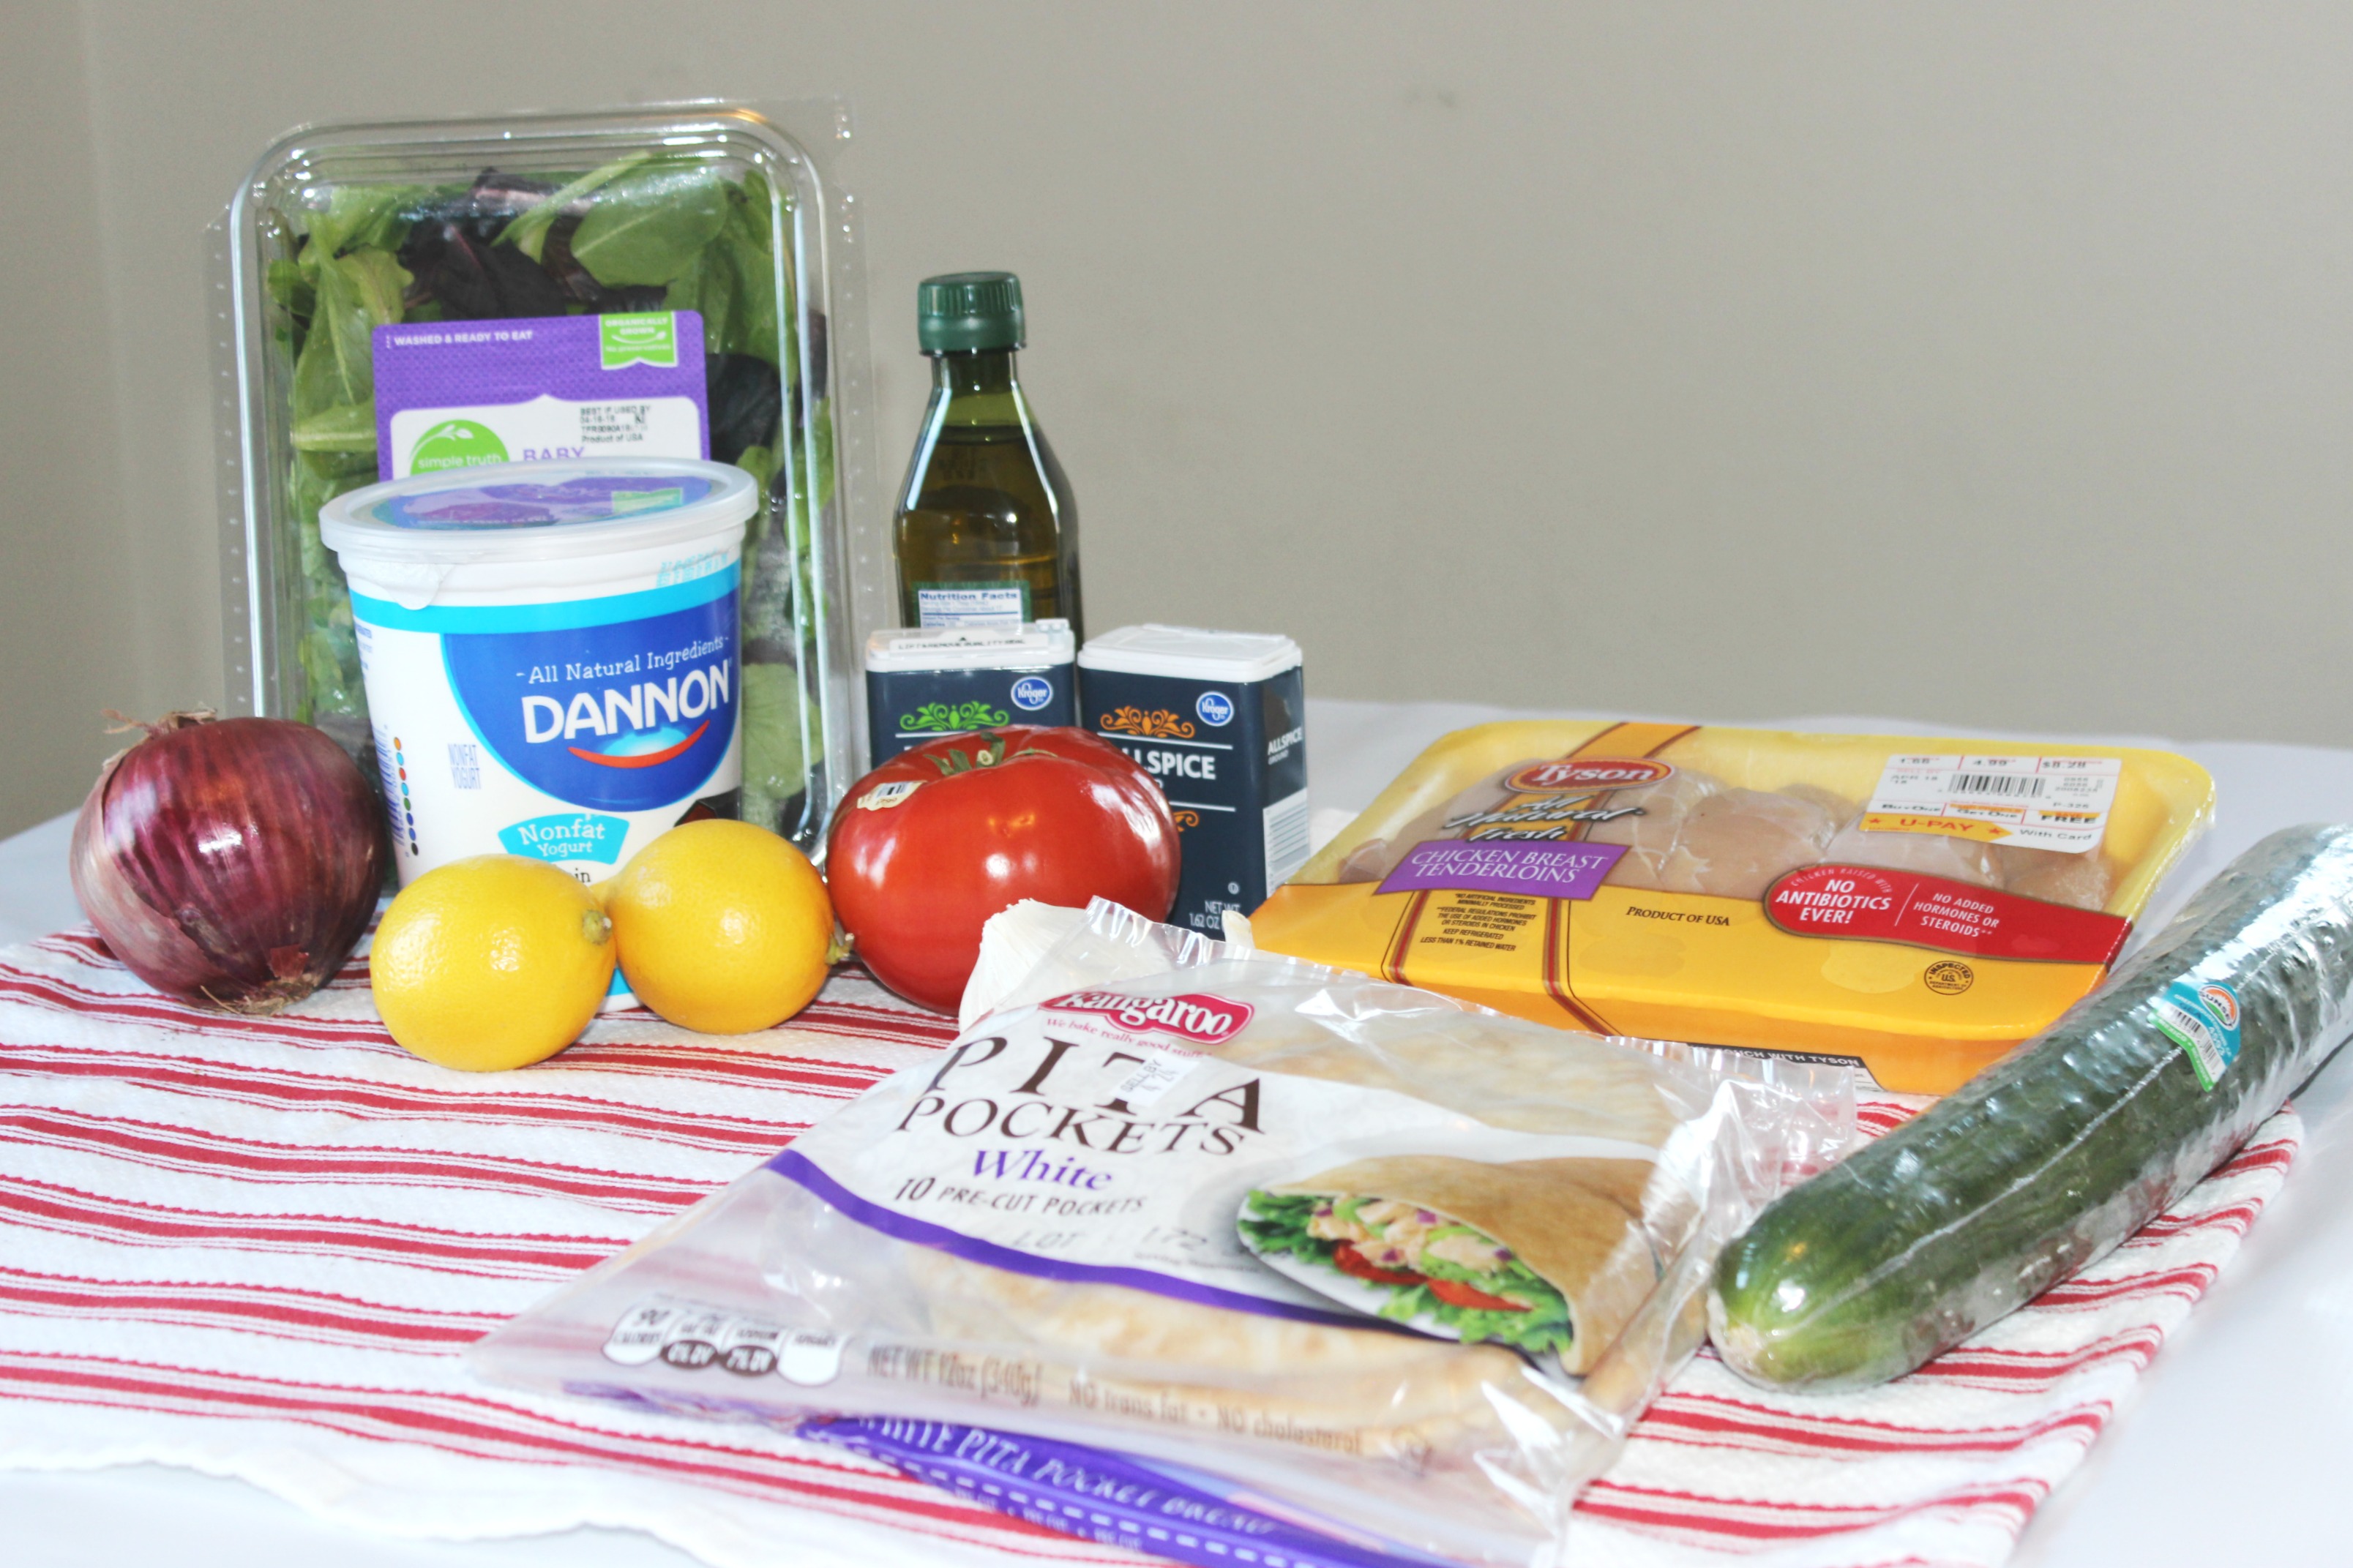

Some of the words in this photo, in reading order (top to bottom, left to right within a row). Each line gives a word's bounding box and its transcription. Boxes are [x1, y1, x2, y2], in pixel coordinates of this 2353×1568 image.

[605, 317, 667, 326] ORGANICALLY
[394, 334, 442, 345] WASHED
[444, 334, 452, 343] &
[454, 332, 491, 343] READY
[494, 331, 509, 341] TO
[512, 331, 533, 340] EAT
[620, 327, 655, 335] GROWN
[580, 407, 601, 416] BEST
[615, 405, 637, 414] USED
[582, 435, 613, 443] Product
[616, 433, 624, 442] of
[626, 433, 643, 442] USA
[418, 455, 463, 469] simple
[466, 453, 501, 465] truth
[523, 446, 585, 462] BABY
[920, 593, 976, 601] Nutrition
[981, 592, 1017, 600] Facts
[565, 655, 640, 681] Natural
[647, 637, 725, 670] Ingredients
[521, 659, 729, 743] DANNON
[1017, 682, 1047, 705] Kroger
[1202, 697, 1229, 720] Kroger
[1268, 727, 1303, 756] ALLSPICE
[1533, 763, 1655, 786] Tyson
[1508, 795, 1594, 813] All
[2040, 814, 2096, 824] FREE
[517, 818, 605, 845] Nonfat
[1466, 825, 1566, 843] Fresh
[1900, 818, 1975, 831] U-PAY
[2020, 829, 2052, 838] With
[2057, 833, 2092, 841] Card
[536, 841, 592, 858] Yogurt
[1411, 849, 1520, 865] CHICKEN
[1522, 852, 1608, 870] BREAST
[1415, 863, 1579, 883] TENDERLOINS
[1790, 868, 1835, 887] CHICKEN
[1840, 868, 1877, 880] RAISED
[1874, 878, 1893, 893] WITH
[1825, 879, 1855, 893] NO
[1205, 900, 1222, 914] NET
[1466, 893, 1496, 901] ARTIFICIAL
[1498, 896, 1536, 905] INGREDIENTS
[1489, 901, 1525, 910] PROCESSED
[1776, 890, 1892, 911] ANTIBIOTICS
[1932, 893, 1952, 904] NO
[1953, 897, 1994, 915] ADDED
[1189, 913, 1205, 928] 1.62
[1206, 915, 1220, 929] OZ
[1468, 908, 1508, 918] REGULATIONS
[1509, 912, 1537, 920] PROHIBIT
[1493, 917, 1527, 926] HORMONES
[1626, 906, 1686, 922] PRODUCT
[1705, 915, 1730, 926] USA
[1800, 907, 1854, 924] EVER!
[1913, 901, 1980, 924] HORMONES
[1982, 917, 2000, 929] OR
[1451, 920, 1481, 928] STEROIDS
[1489, 923, 1516, 931] CHICKEN
[1460, 929, 1504, 939] REFRIGERATED
[1465, 939, 1495, 949] RETAINED
[1495, 942, 1516, 951] WATER
[1929, 962, 1971, 979] INSPECTED
[1069, 1021, 1098, 1035] bake
[1101, 1030, 1135, 1044] really
[1137, 1039, 1170, 1052] good
[2158, 1019, 2188, 1042] MEXICO
[1768, 1051, 1806, 1062] WITH
[1810, 1055, 1860, 1067] TYSON
[925, 1036, 1265, 1134] PITA
[895, 1097, 1246, 1156] POCKETS
[973, 1149, 1112, 1191] White
[894, 1177, 935, 1201] 10
[938, 1186, 1038, 1212] PRE-CUT
[1043, 1196, 1148, 1218] POCKETS
[867, 1345, 903, 1381] NET
[905, 1348, 934, 1383] WT
[1069, 1378, 1096, 1411] NO
[1104, 1389, 1153, 1418] trans
[1160, 1395, 1189, 1423] fat
[1216, 1403, 1244, 1434] NO
[1253, 1409, 1363, 1455] cholesterol
[859, 1417, 953, 1452] HITE
[954, 1428, 1031, 1474] PITA
